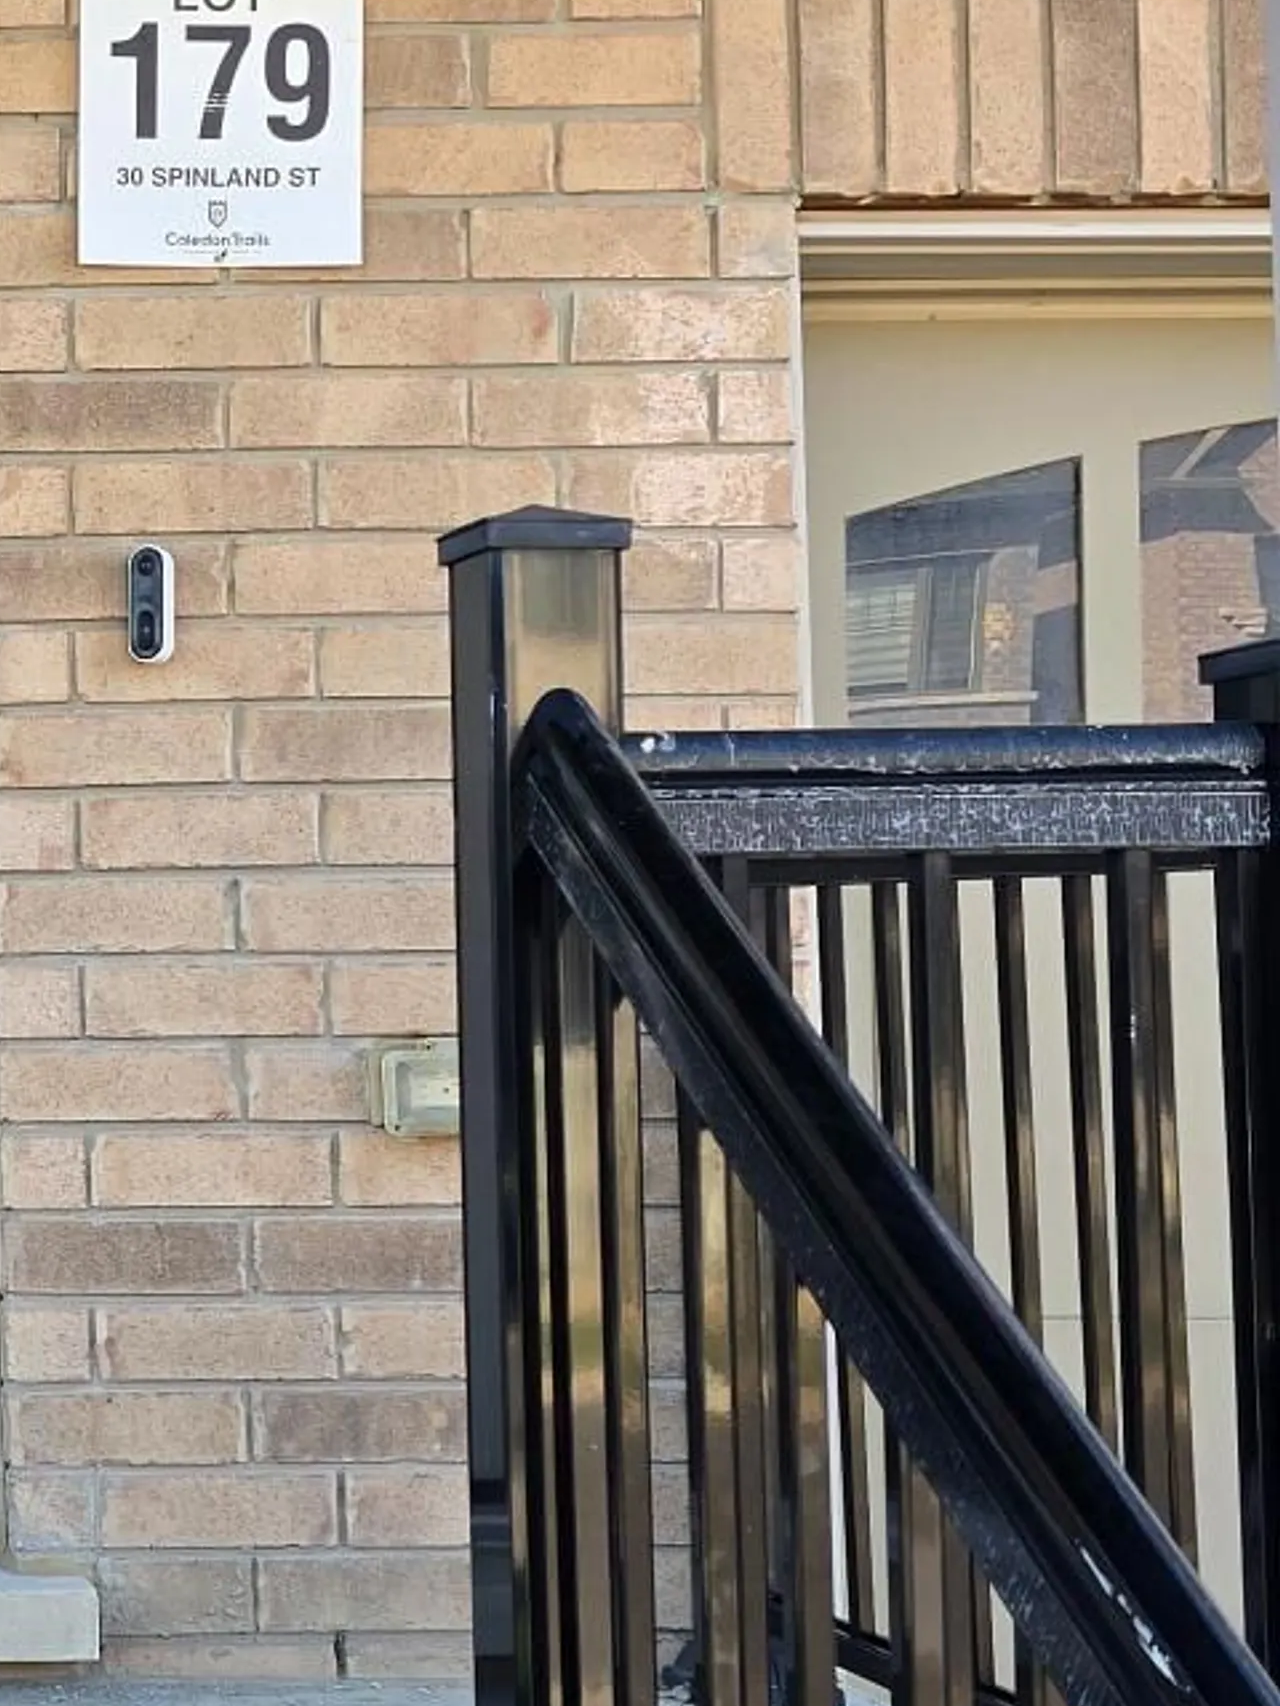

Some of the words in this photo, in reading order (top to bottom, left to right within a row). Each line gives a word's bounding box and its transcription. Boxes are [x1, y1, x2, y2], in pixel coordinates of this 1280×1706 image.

[110, 22, 331, 142] 179
[116, 168, 143, 188] 30
[152, 167, 281, 188] SPINLAND
[288, 167, 321, 188] ST
